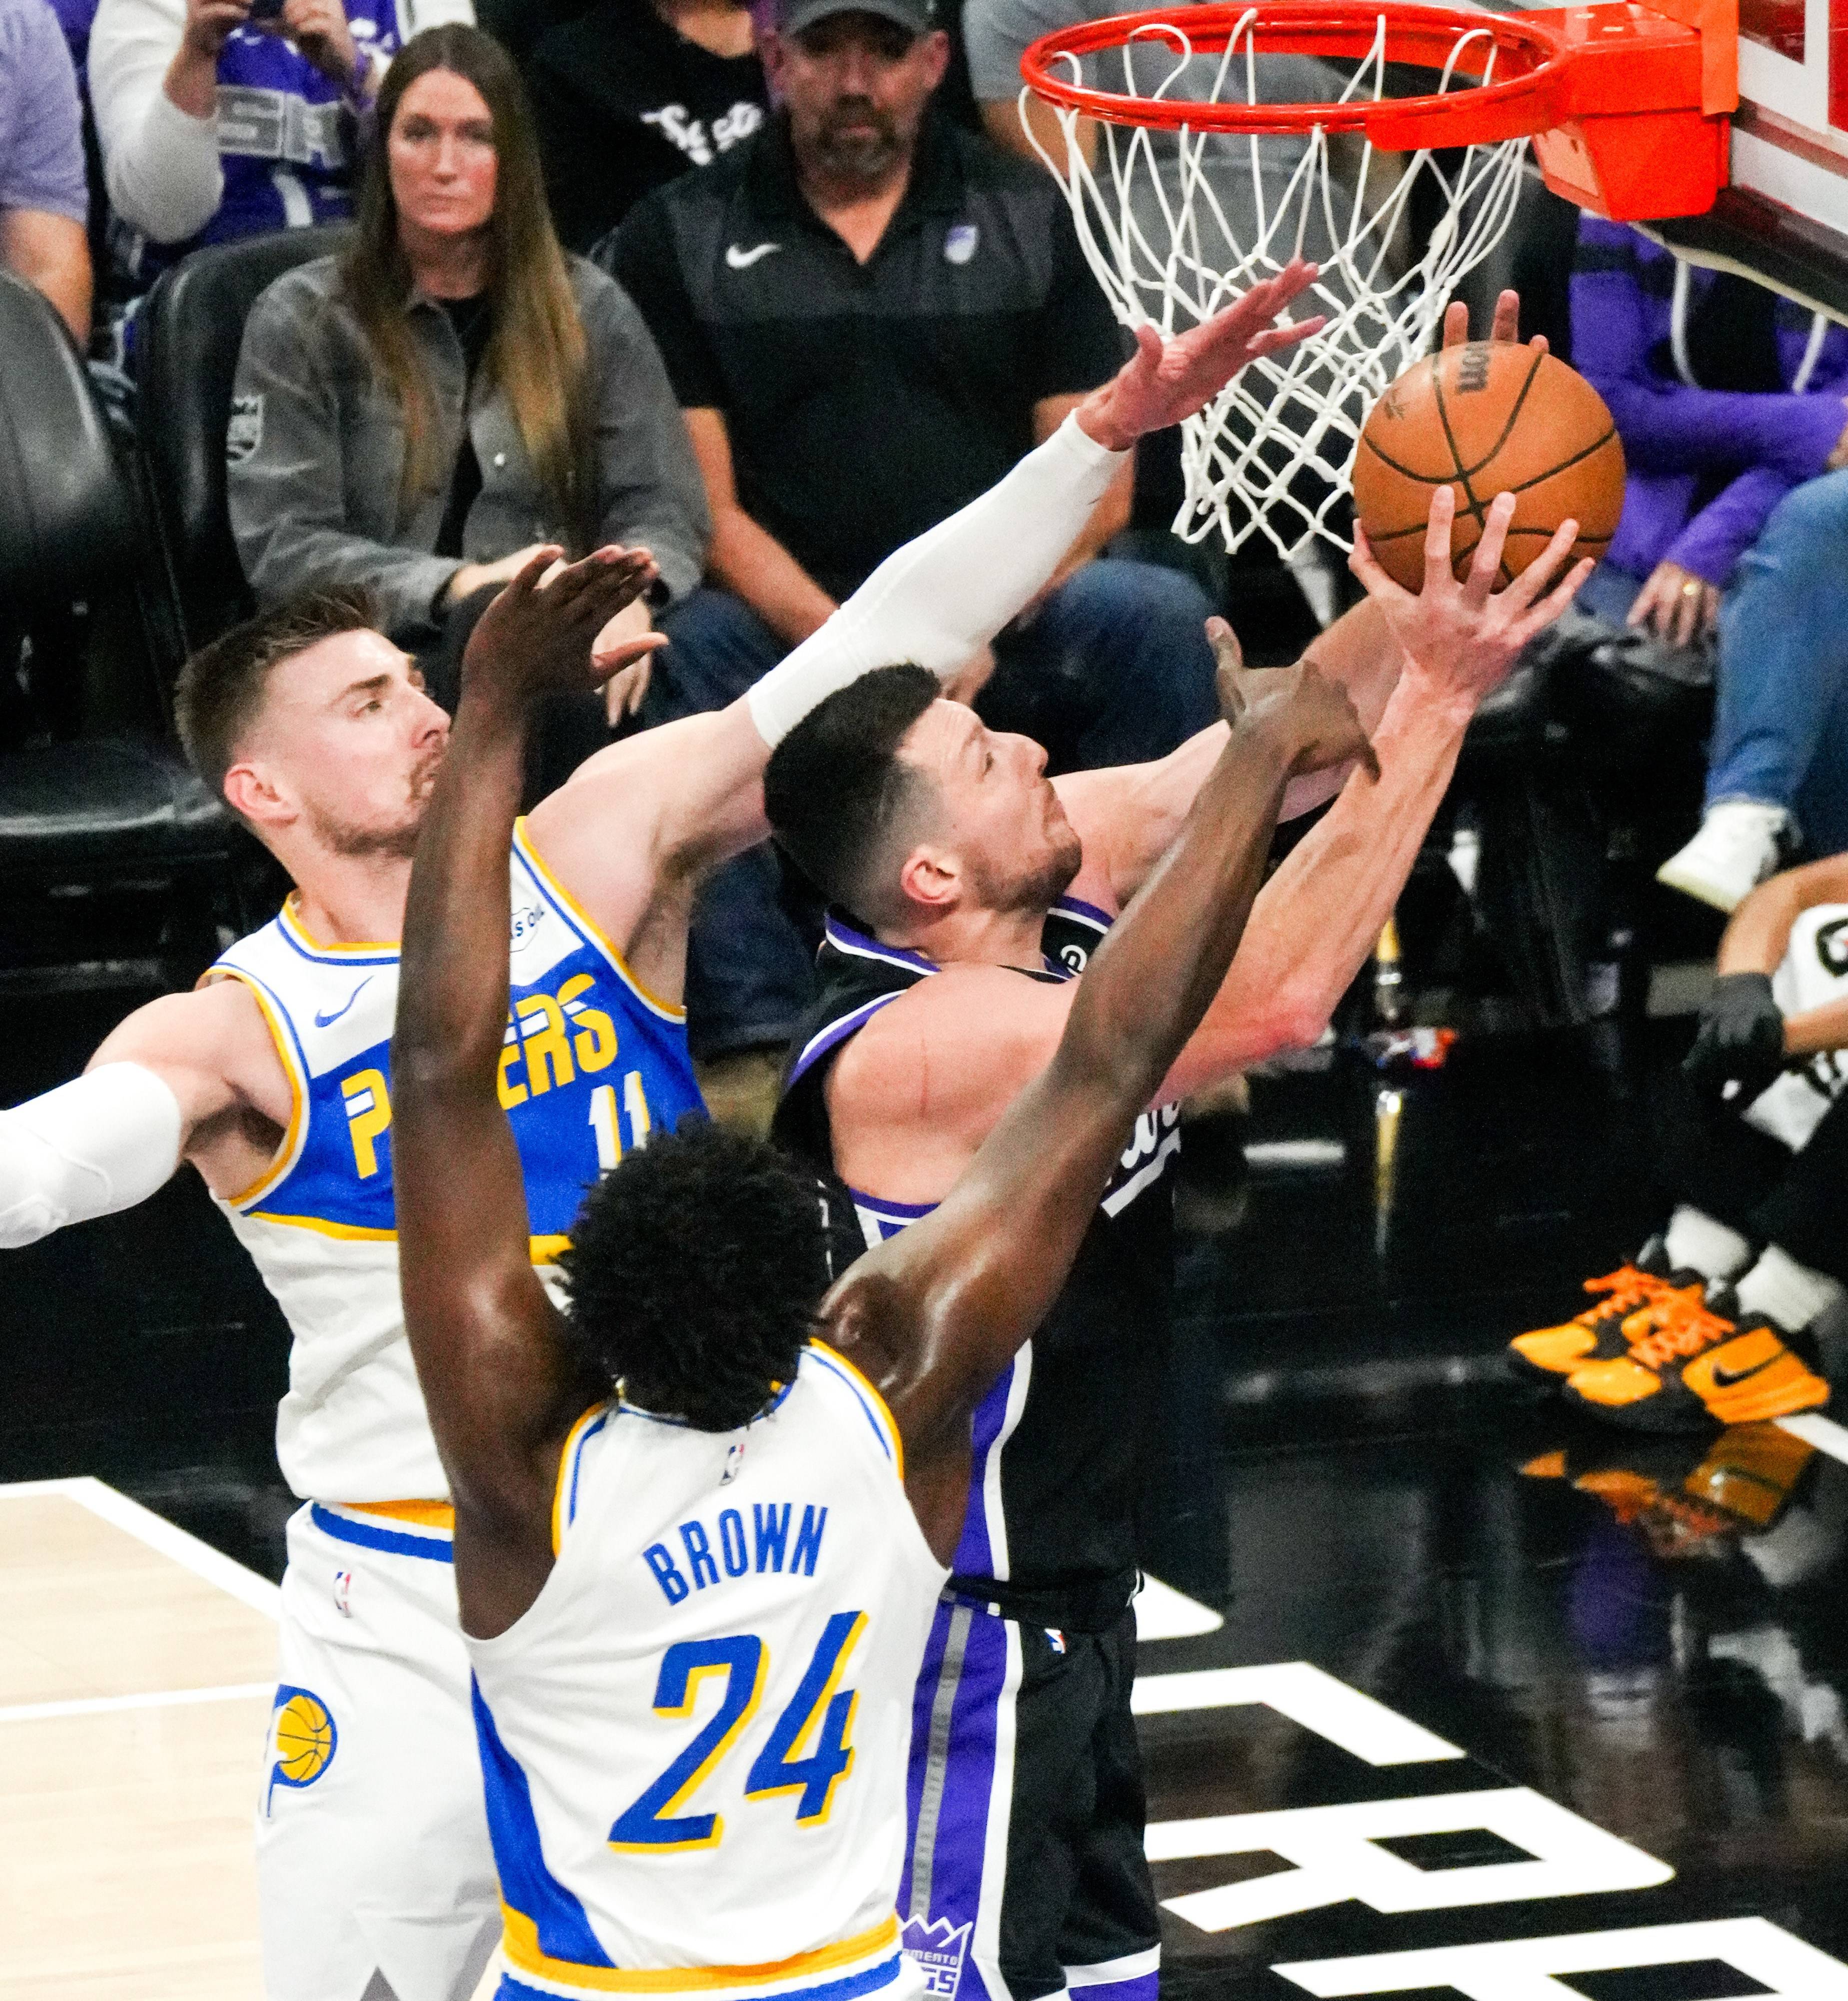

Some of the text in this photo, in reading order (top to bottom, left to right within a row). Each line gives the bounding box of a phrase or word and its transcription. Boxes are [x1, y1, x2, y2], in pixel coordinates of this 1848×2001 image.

[341, 972, 618, 1180] PERS
[588, 1070, 651, 1177] 11
[642, 1502, 828, 1606] BROWN
[608, 1610, 869, 1854] 24
